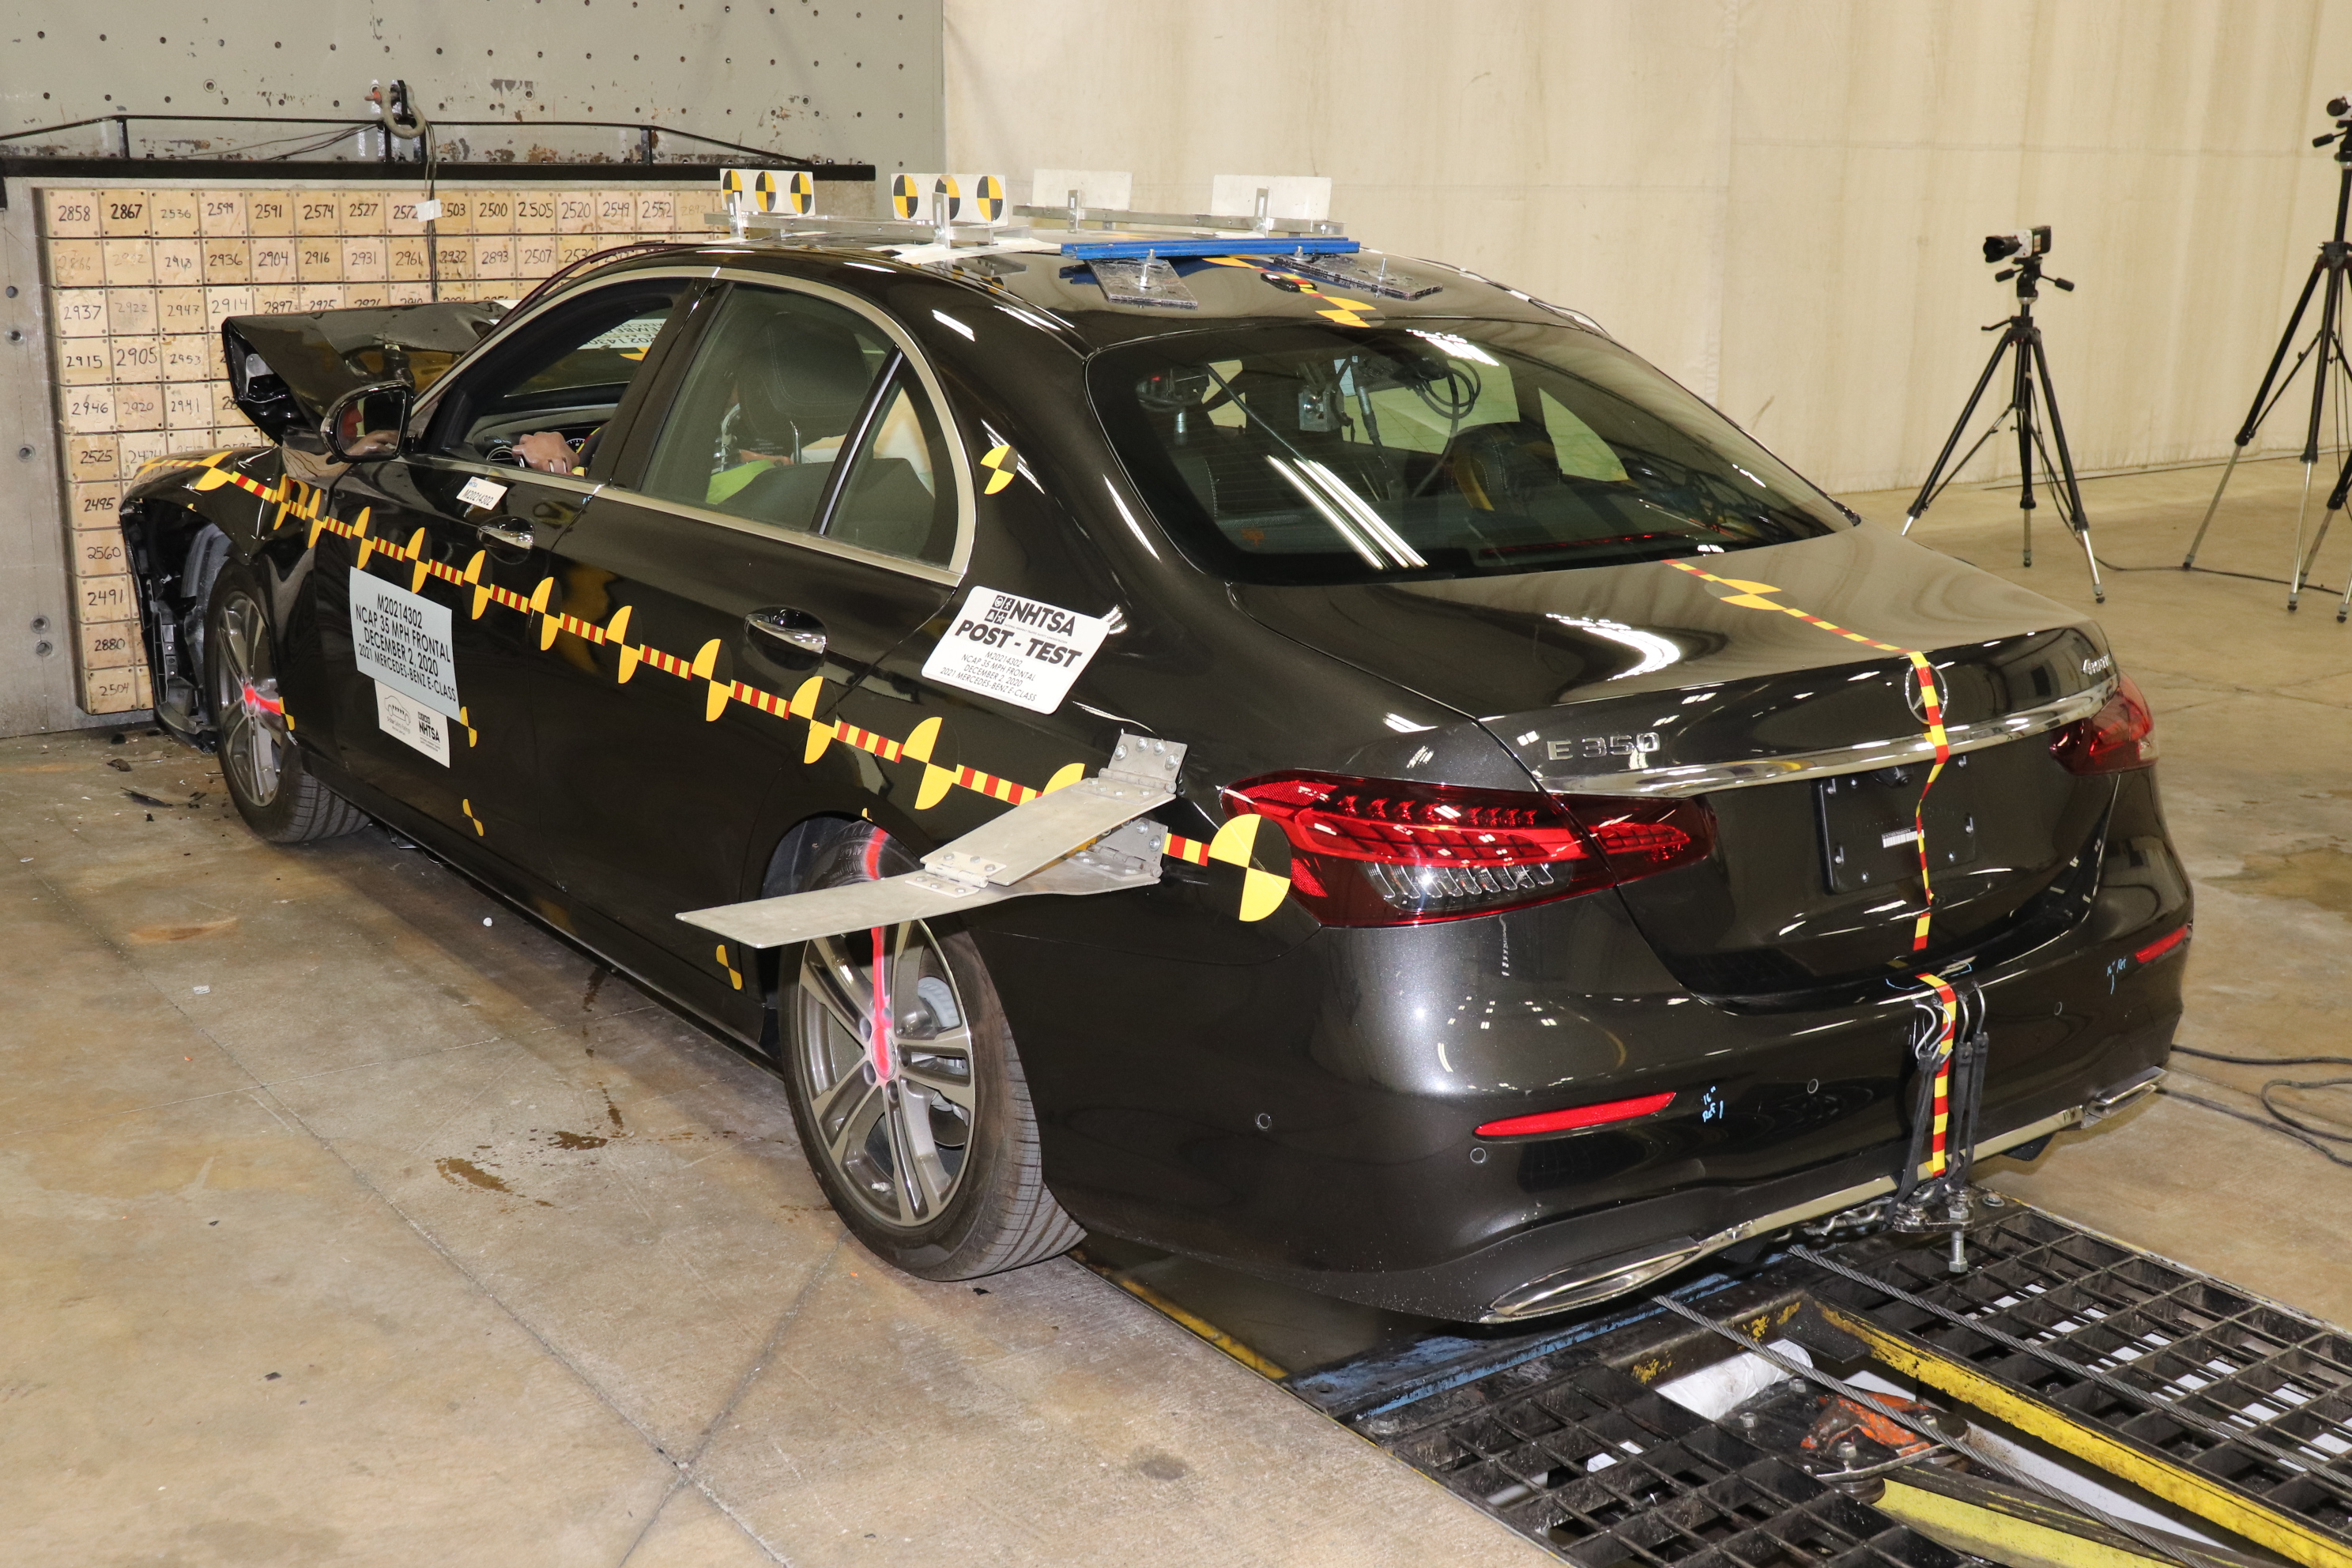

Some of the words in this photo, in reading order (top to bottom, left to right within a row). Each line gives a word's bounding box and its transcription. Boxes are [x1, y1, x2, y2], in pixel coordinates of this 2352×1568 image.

[58, 205, 90, 221] 2858
[111, 204, 142, 220] 2867
[160, 209, 191, 219] 2536
[207, 203, 233, 216] 2599
[255, 204, 282, 219] 2591
[303, 204, 334, 220] 2574
[349, 203, 378, 217] 2527
[480, 202, 508, 217] 2500
[518, 202, 553, 217] 2505
[562, 202, 590, 219] 2520
[603, 202, 629, 217] 2549
[643, 201, 672, 218] 2552
[209, 254, 243, 266] 2936
[258, 251, 288, 267] 2904
[305, 251, 330, 264] 2916
[352, 251, 376, 266] 2931
[439, 251, 466, 264] 2932
[482, 251, 509, 265] 2893
[525, 249, 552, 264] 2507
[64, 305, 101, 320] 2937
[115, 302, 149, 313] 2922
[168, 305, 200, 317] 2947
[212, 299, 247, 314] 2914
[264, 301, 292, 314] 2897
[66, 356, 102, 368] 2915
[116, 346, 157, 366] 2905
[170, 354, 201, 365] 2953
[72, 394, 108, 415] 2946
[81, 450, 113, 464] 2525
[85, 497, 115, 512] 2495
[462, 488, 494, 506] M20214302
[87, 547, 121, 560] 2560
[88, 590, 122, 605] 2491
[377, 594, 422, 629] M20214302
[1008, 600, 1076, 636] NHTSA
[356, 603, 378, 628] NCAP
[380, 616, 389, 634] 35
[392, 620, 409, 643] MPH
[413, 630, 450, 663] FRONTAL
[95, 638, 126, 651] 2880
[955, 620, 1014, 649] POST
[1025, 638, 1083, 668] TEST
[364, 627, 406, 662] DECEMBER
[409, 648, 416, 669] 2,
[418, 652, 439, 677] 2020
[985, 651, 1023, 667] M20214302
[358, 643, 373, 662] 2021
[375, 651, 426, 687] MERCEDES-BENZ
[428, 676, 456, 702] E-CLASS
[961, 654, 982, 664] NCAP
[990, 662, 1007, 672] MPH
[1006, 667, 1036, 681] FRONTAL
[964, 665, 999, 681] DECEMBER
[1006, 677, 1023, 687] 2020
[100, 683, 129, 696] 2504
[940, 667, 956, 677] 2021
[956, 672, 1008, 692] MERCEDES-BENZ
[1008, 687, 1037, 702] E-CLASS
[419, 720, 440, 743] NHTSA
[1547, 741, 1574, 760] E
[1582, 732, 1660, 757] 350
